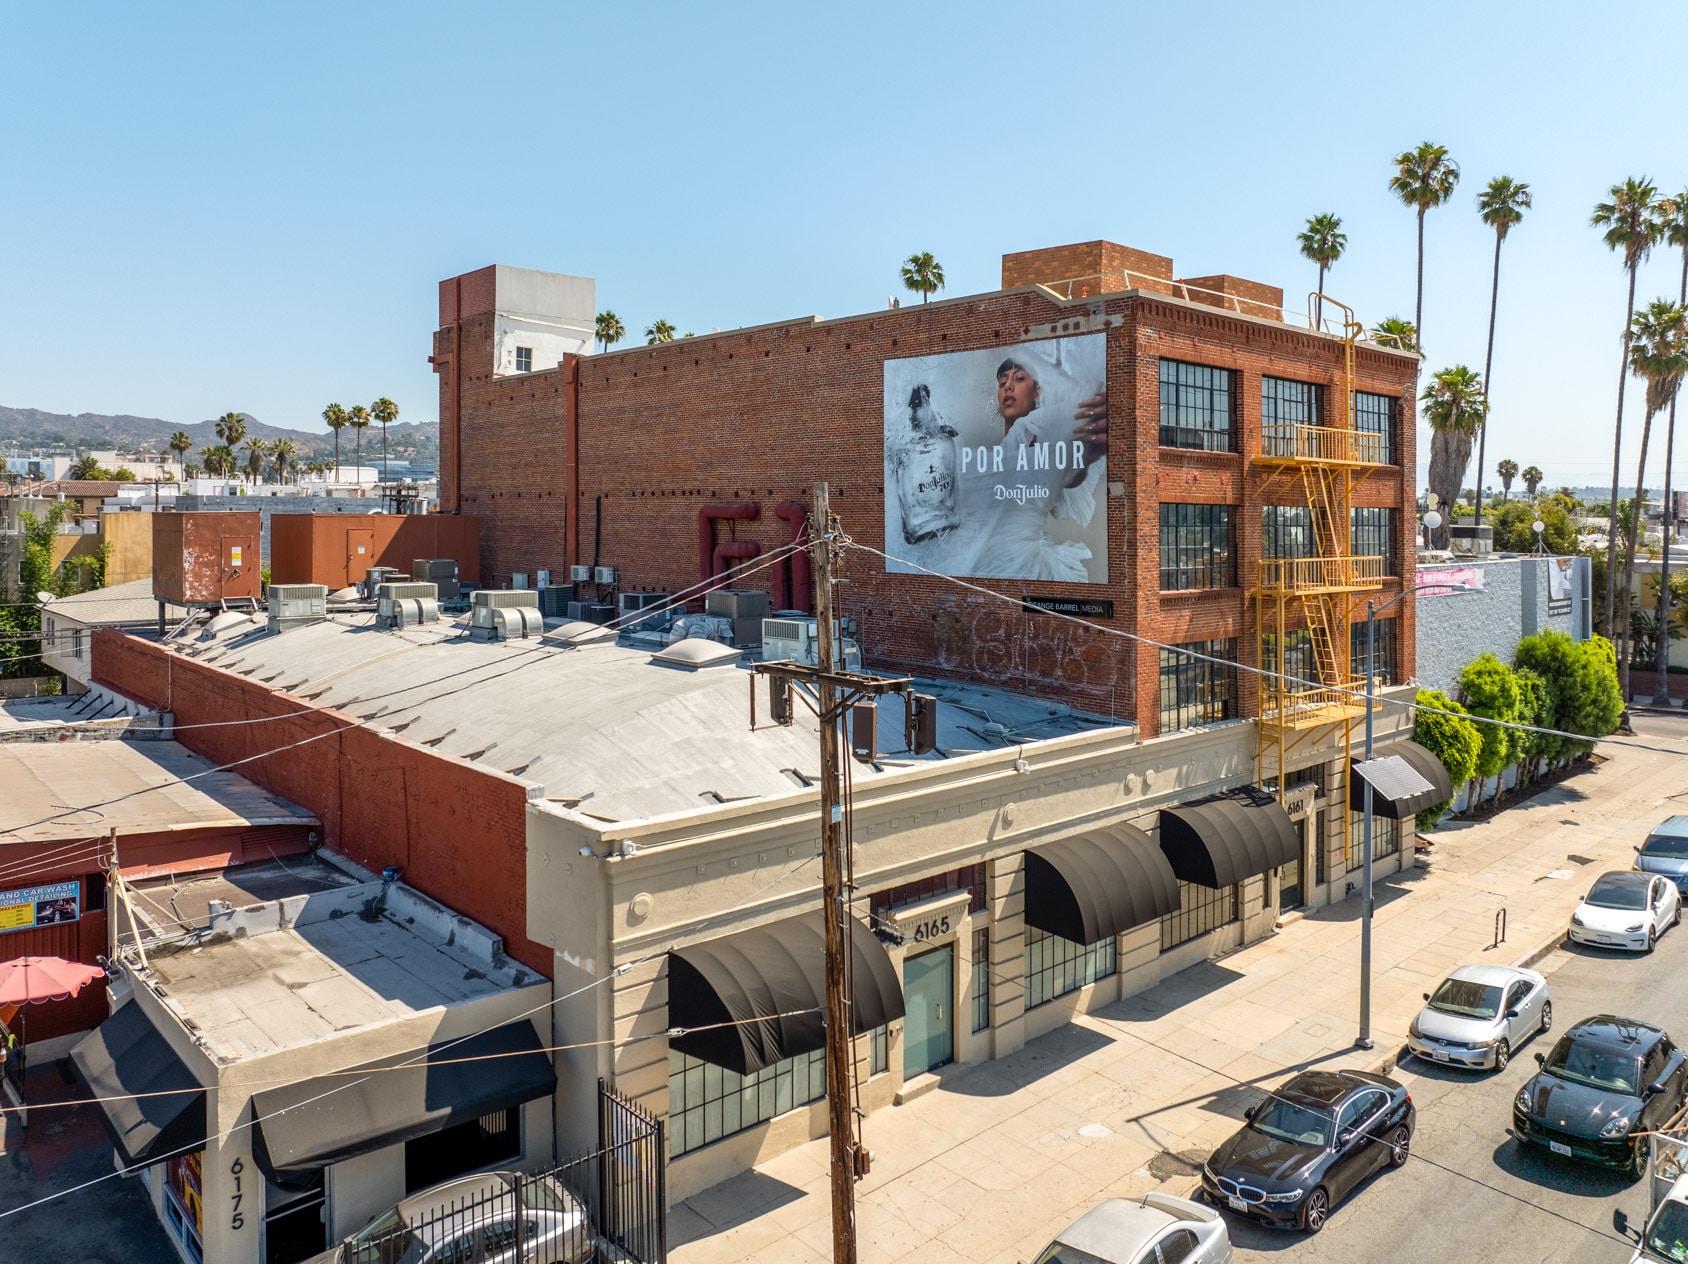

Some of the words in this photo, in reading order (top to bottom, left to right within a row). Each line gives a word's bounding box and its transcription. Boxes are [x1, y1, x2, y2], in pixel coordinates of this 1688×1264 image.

[962, 445, 1004, 473] POR
[1016, 440, 1085, 470] AMOR
[1055, 603, 1080, 612] BARREL
[1082, 605, 1104, 613] MEDIA
[1288, 799, 1304, 816] 6161
[24, 888, 43, 896] CAR
[47, 884, 75, 893] WASH
[29, 891, 72, 902] DETAILING
[914, 916, 950, 942] 6165
[230, 1157, 244, 1230] 6175
